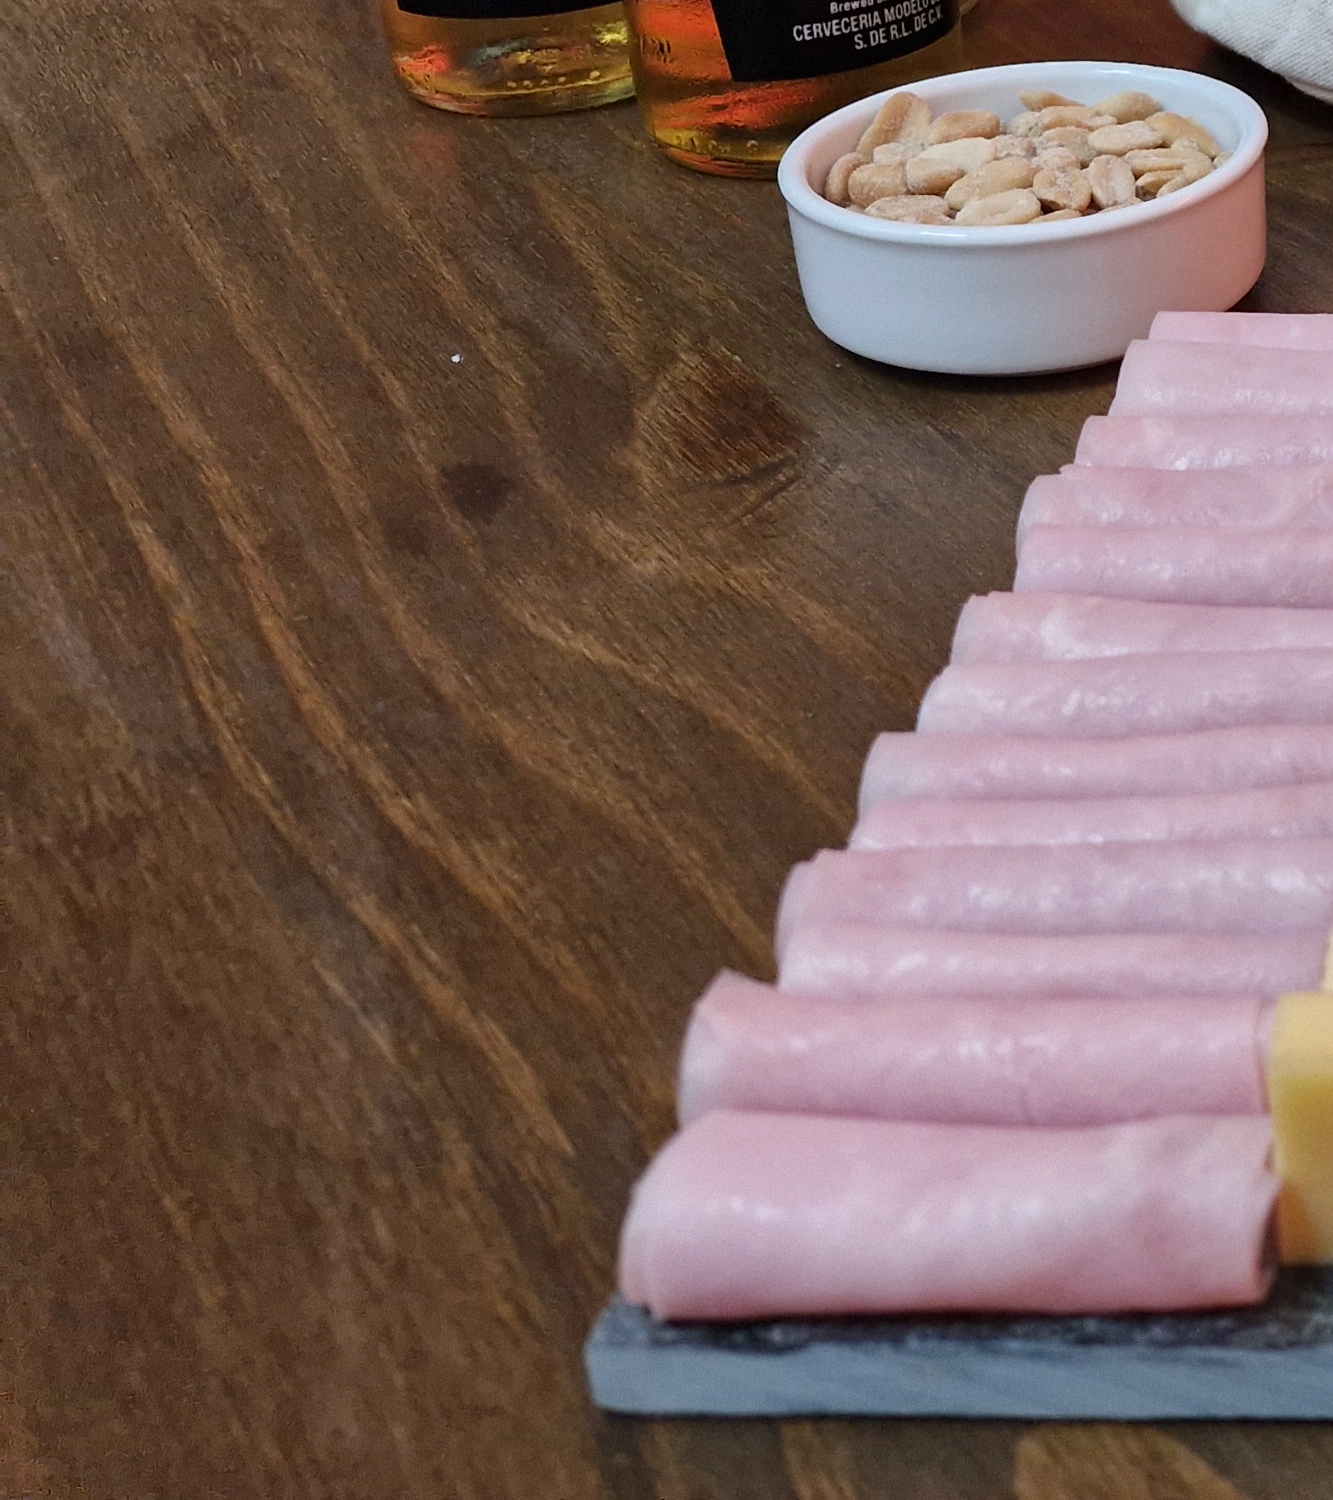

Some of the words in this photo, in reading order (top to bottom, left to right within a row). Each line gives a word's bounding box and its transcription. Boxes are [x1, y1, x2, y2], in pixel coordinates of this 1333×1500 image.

[793, 10, 882, 41] CERVECERIA
[854, 33, 868, 50] S.
[869, 27, 888, 46] DE
[890, 21, 913, 41] R.L.
[914, 15, 929, 32] DE
